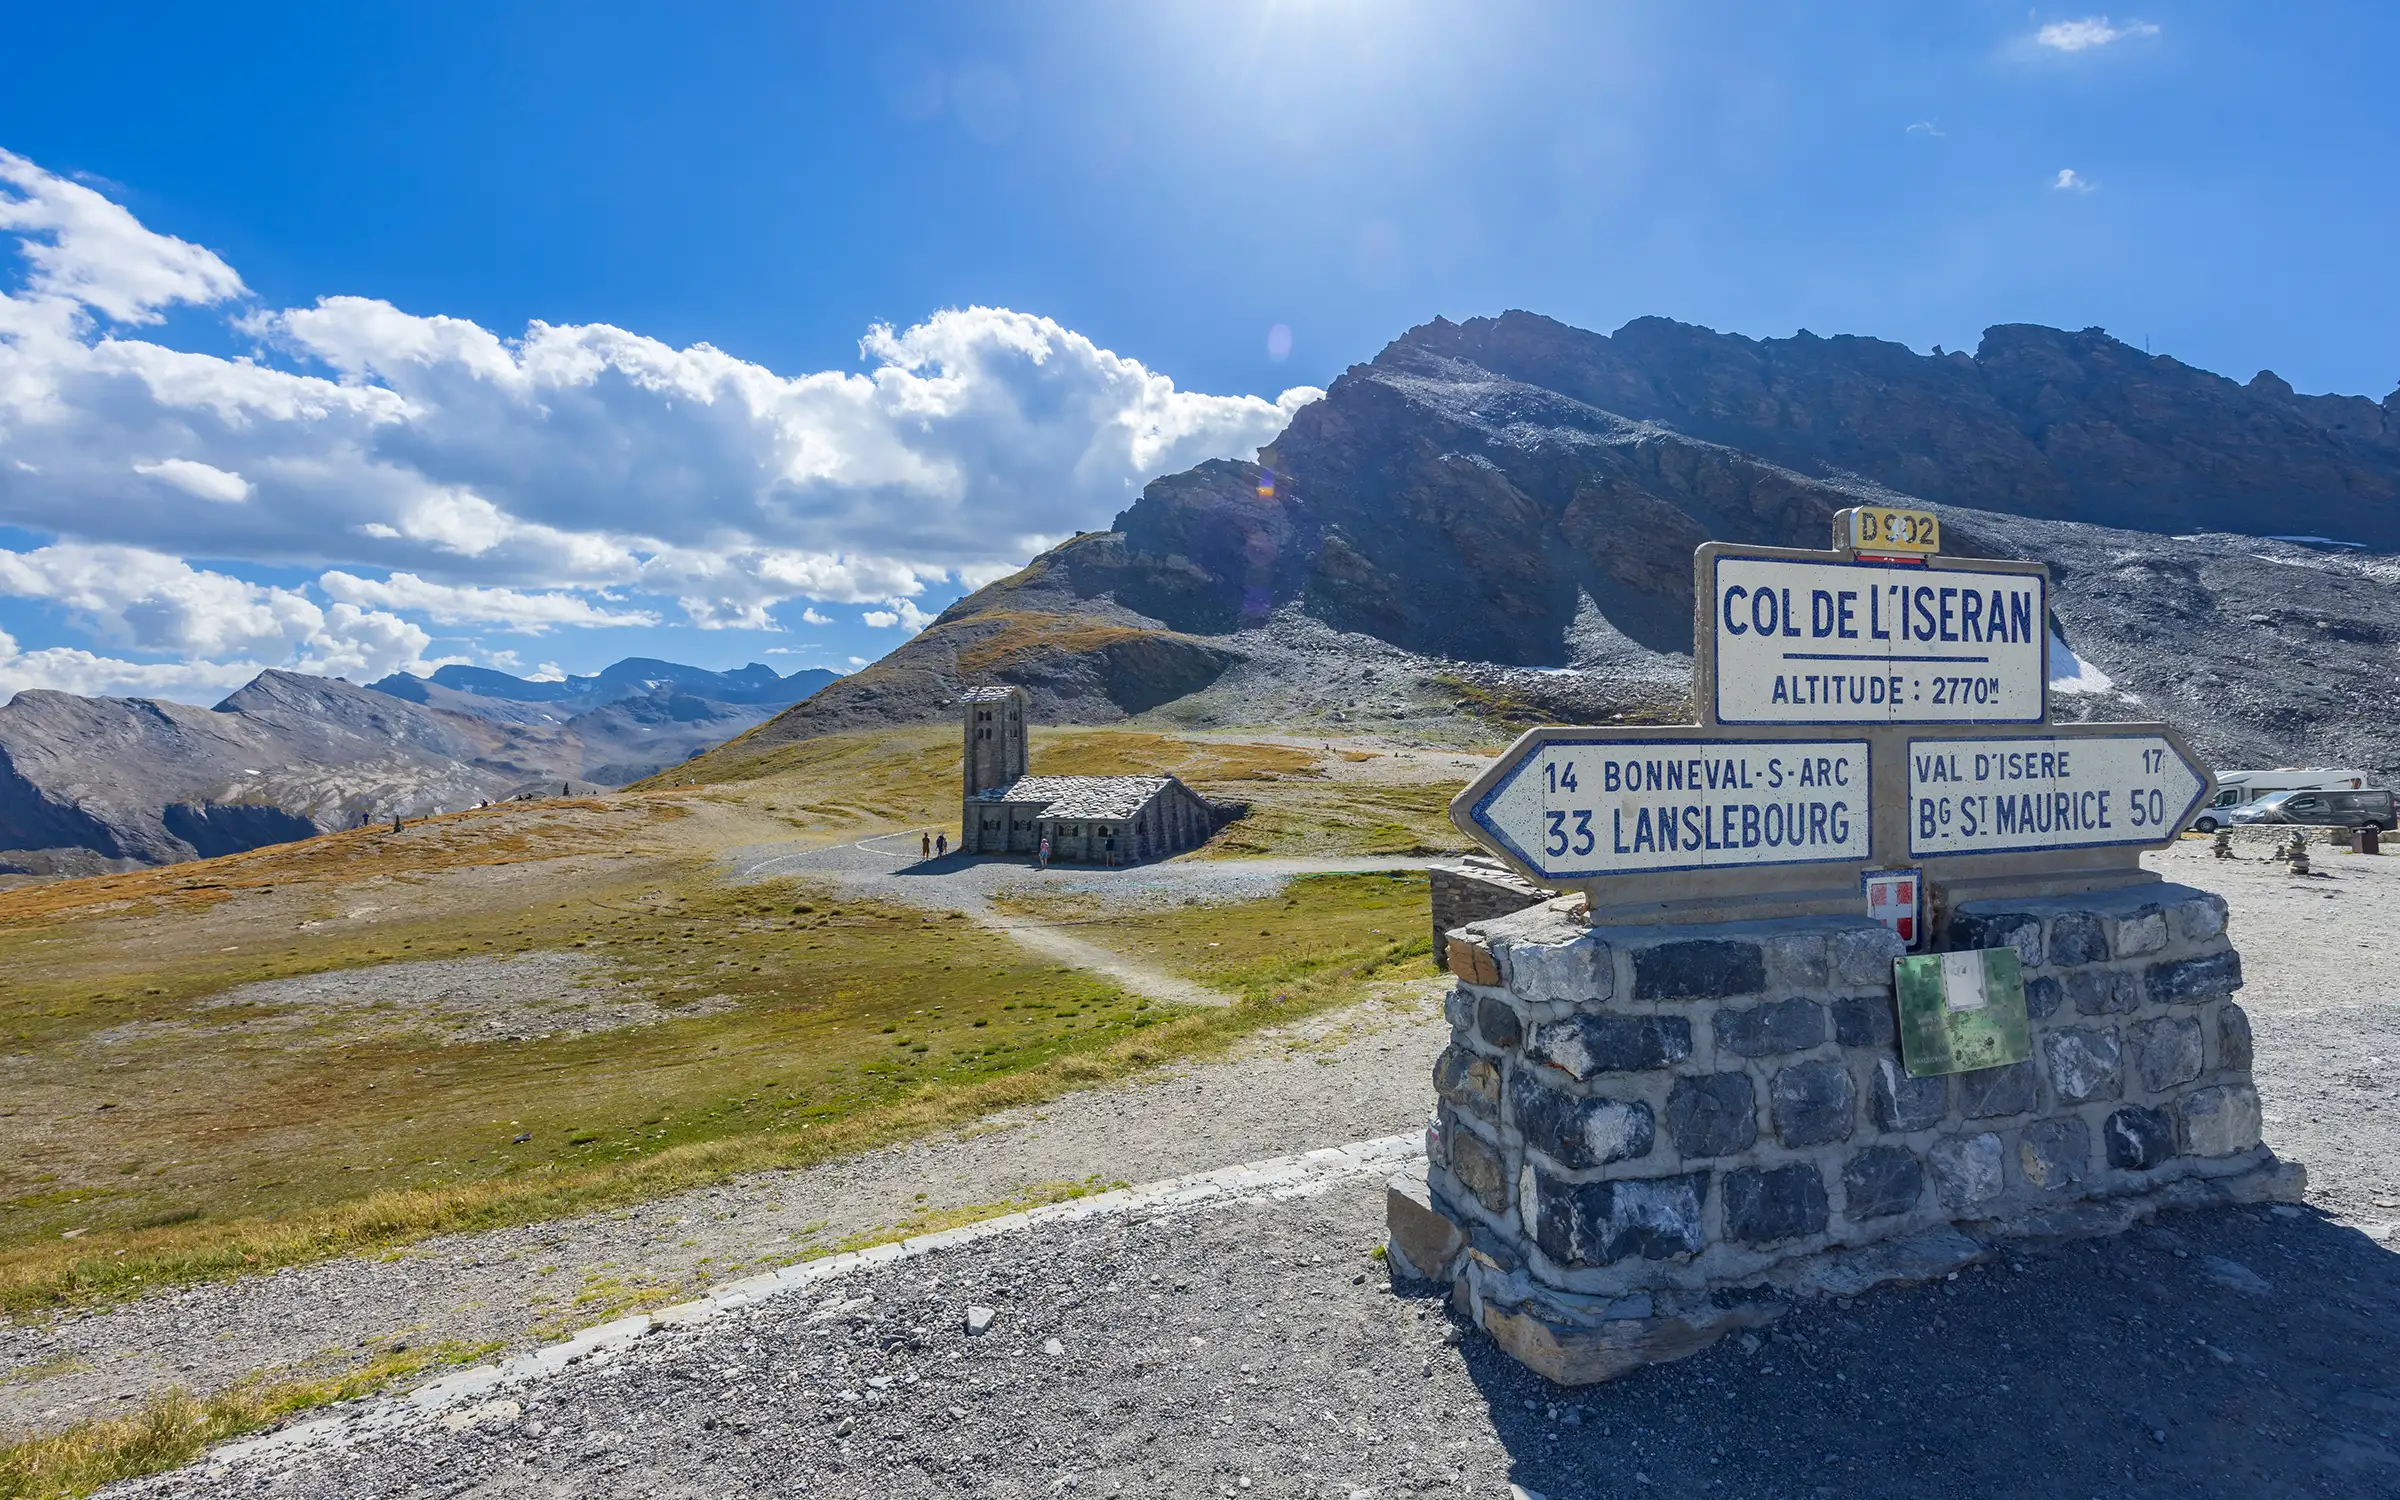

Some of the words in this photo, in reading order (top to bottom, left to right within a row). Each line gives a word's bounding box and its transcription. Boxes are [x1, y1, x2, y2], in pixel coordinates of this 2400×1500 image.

[1862, 512, 1878, 541] D
[1723, 584, 1802, 637] COL
[1812, 589, 1859, 639] DE
[1871, 584, 2032, 644] L'ISERAN
[1771, 675, 1904, 704] ALTITUDE
[1545, 761, 1579, 794] 14
[1915, 754, 1963, 783] VAL
[1975, 751, 2071, 782] D'ISERE
[2142, 749, 2164, 774] 17
[1996, 791, 2112, 835] MAURICE
[2130, 788, 2164, 827] 50
[1545, 809, 1596, 858] 33
[1613, 801, 1850, 855] LANSLEBOURG
